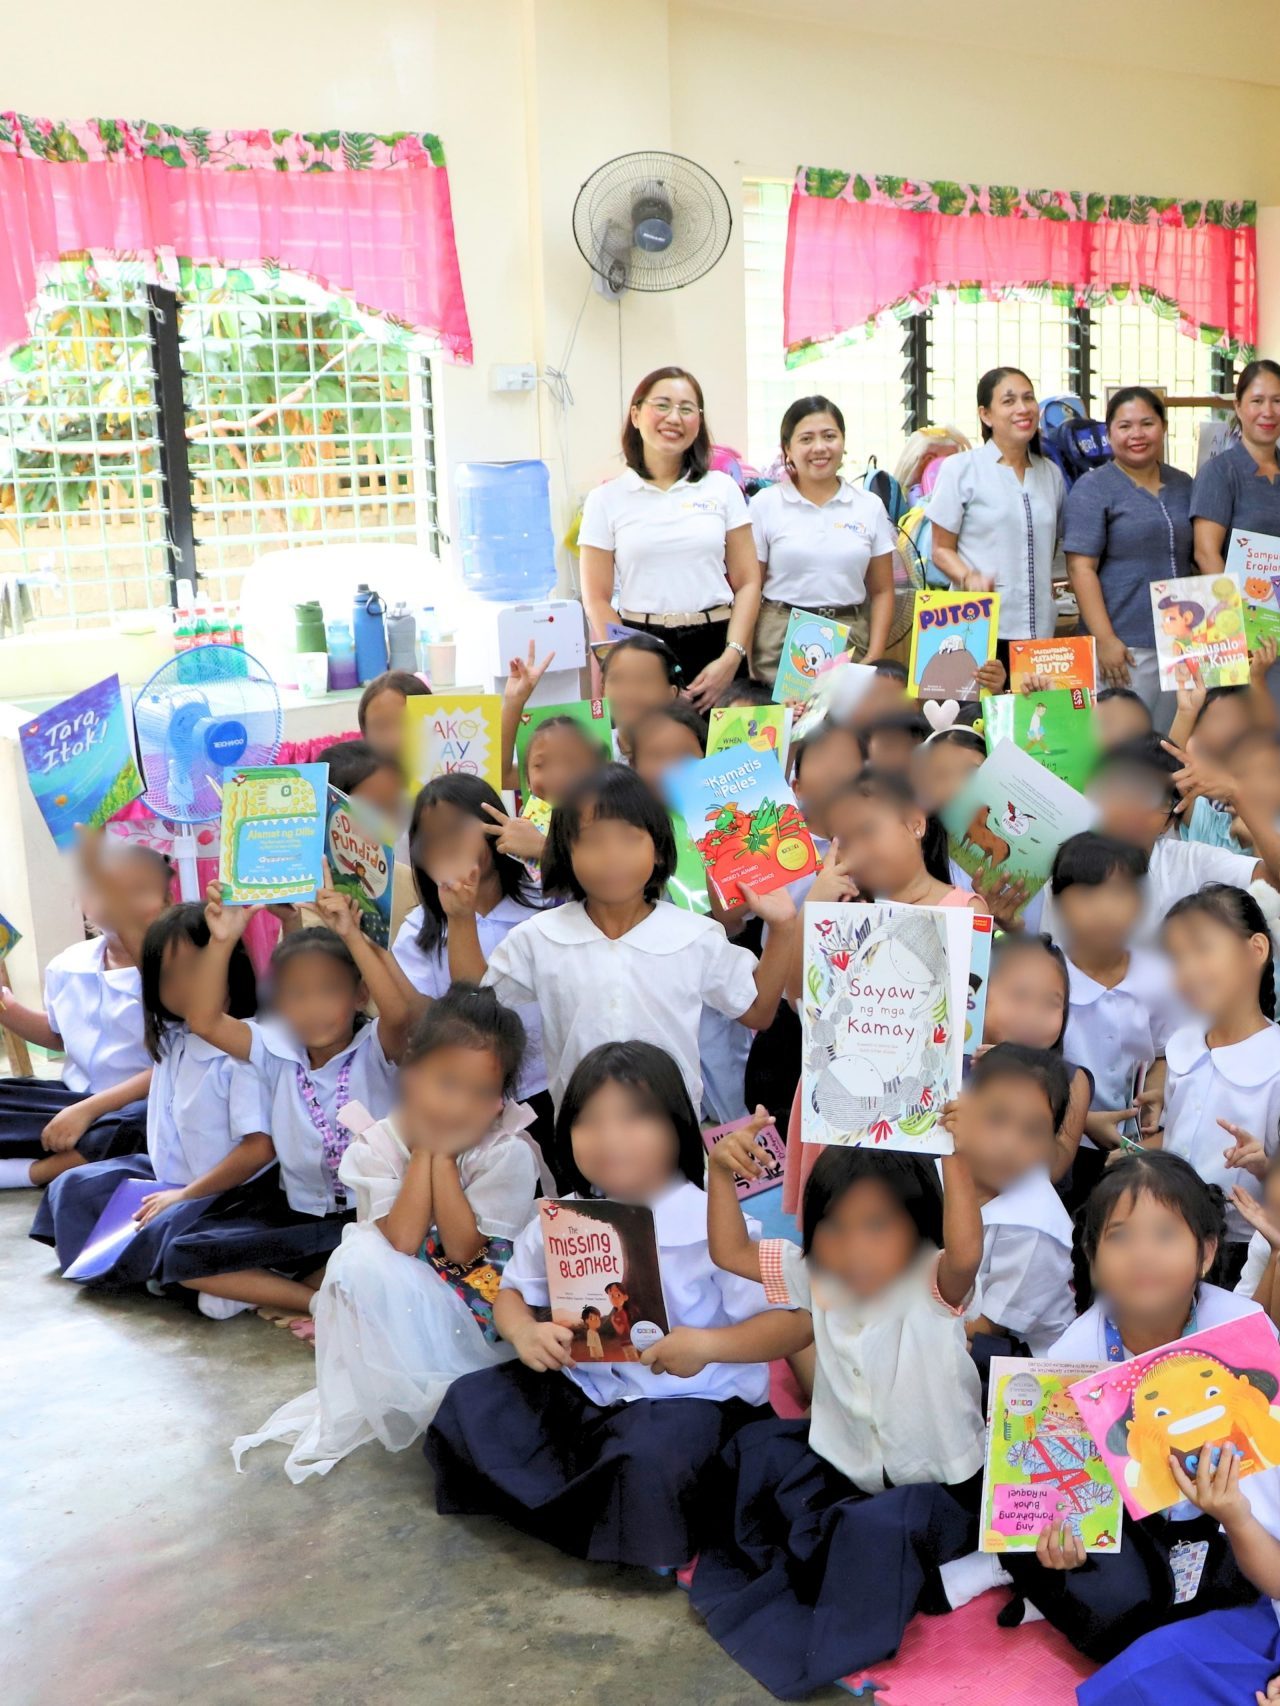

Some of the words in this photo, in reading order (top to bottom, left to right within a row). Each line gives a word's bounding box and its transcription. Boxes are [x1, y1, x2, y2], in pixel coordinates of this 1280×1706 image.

[919, 598, 994, 631] PUTOT
[1035, 661, 1071, 674] BUTO
[45, 710, 100, 747] Tara,
[433, 719, 481, 740] AKO
[43, 720, 107, 774] Itok!
[441, 740, 471, 760] AY
[708, 759, 762, 790] Kamatis
[720, 775, 757, 799] Peles
[331, 830, 386, 875] Pundido
[849, 978, 915, 1004] Sayaw
[860, 1006, 874, 1017] ng
[880, 1007, 905, 1019] mga
[847, 1016, 915, 1044] Kamay
[1007, 1488, 1038, 1499] Raquel
[1040, 1490, 1048, 1498] ni
[998, 1510, 1054, 1521] Pambihirang
[1013, 1500, 1040, 1510] Buhok
[1015, 1521, 1035, 1531] Ang
